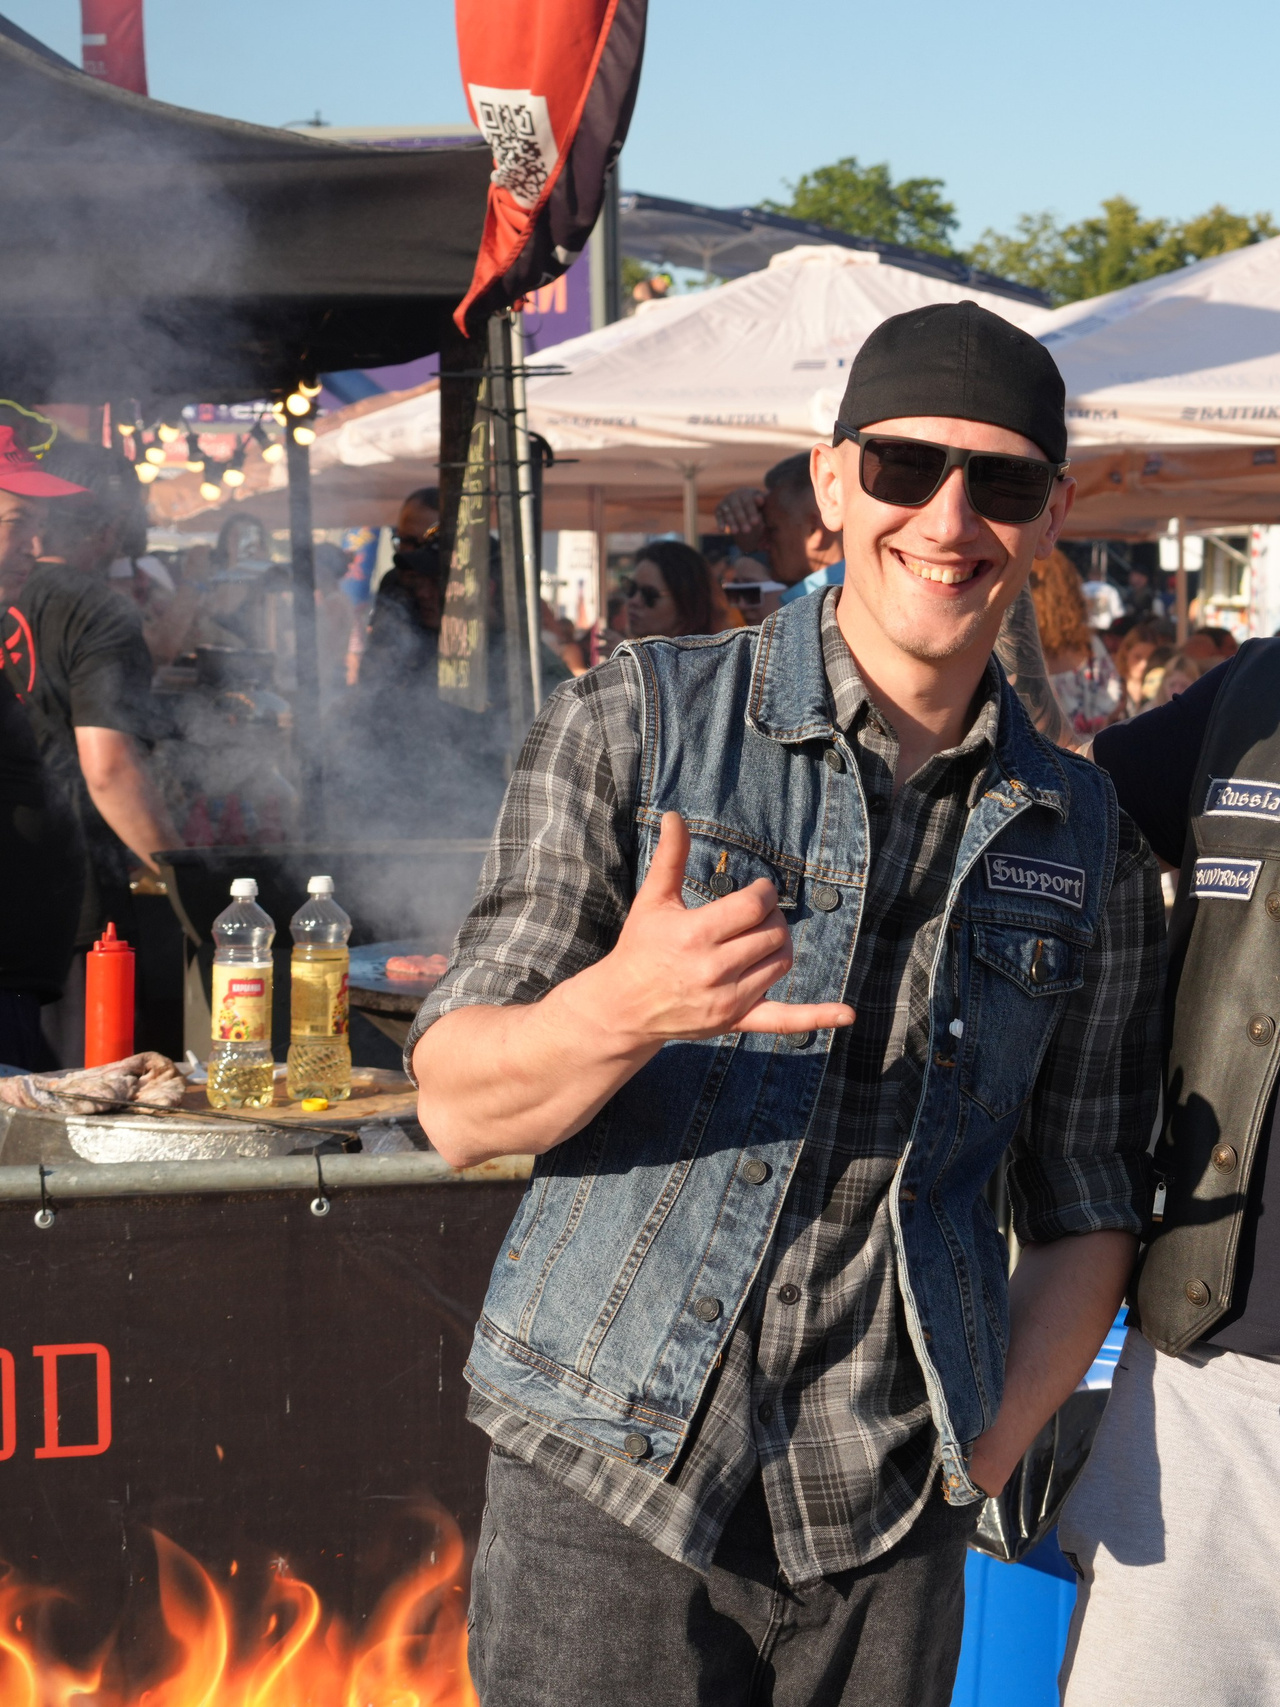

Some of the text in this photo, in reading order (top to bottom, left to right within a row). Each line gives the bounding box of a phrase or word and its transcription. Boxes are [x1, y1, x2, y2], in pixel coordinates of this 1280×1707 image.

[1217, 787, 1280, 811] Russia
[992, 859, 1082, 898] Support
[0, 1343, 112, 1461] D
